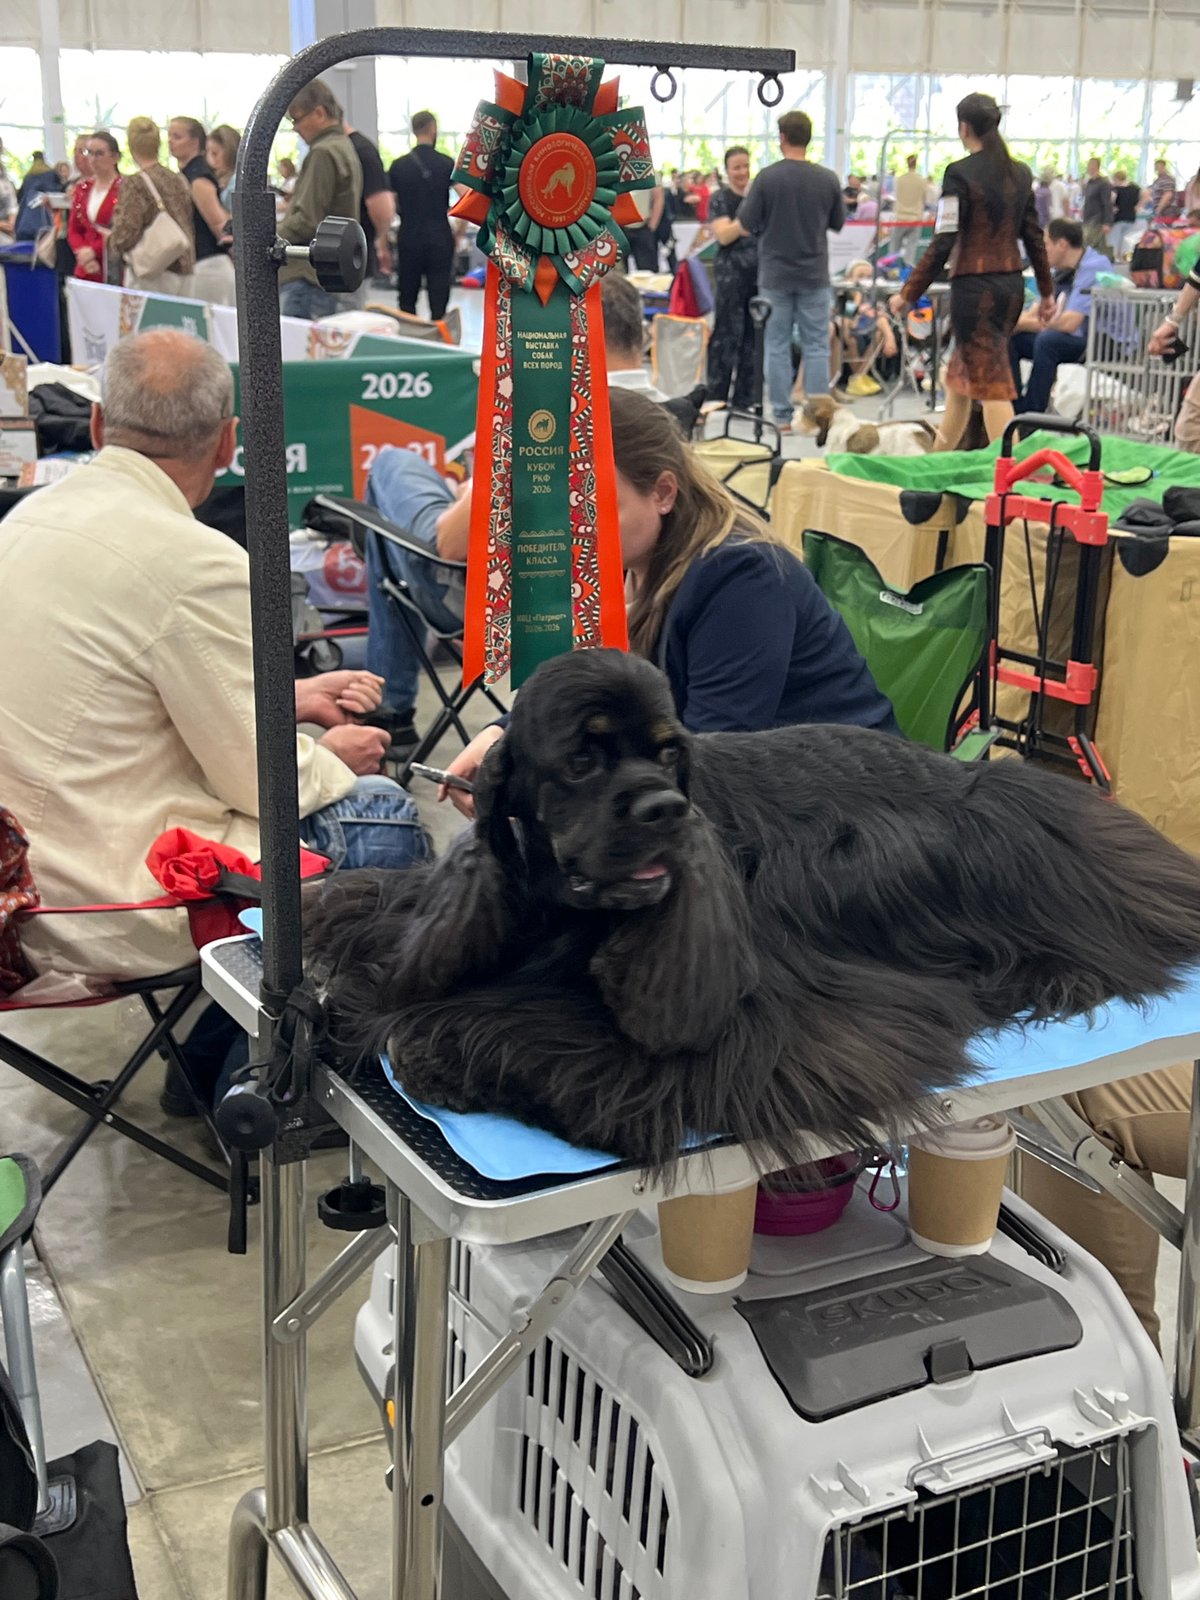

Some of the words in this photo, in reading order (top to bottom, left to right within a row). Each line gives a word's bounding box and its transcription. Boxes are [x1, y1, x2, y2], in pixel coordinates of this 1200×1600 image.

[517, 331, 567, 340] НАЦИОНАЛЬНАЯ
[525, 341, 560, 350] ВЫСТАВКА
[531, 351, 554, 360] СОБАК
[523, 361, 540, 369] ВСЕХ
[540, 361, 563, 370] ПОРОД
[361, 372, 433, 400] 2026
[519, 446, 565, 457] РОССИЯ
[527, 462, 556, 472] КУБОК
[532, 474, 551, 483] РКФ
[532, 485, 552, 495] 2026
[517, 542, 567, 553] ПОБЕДИТЕЛЬ
[526, 556, 558, 565] КЛАССА
[820, 1274, 987, 1328] SKUDO
